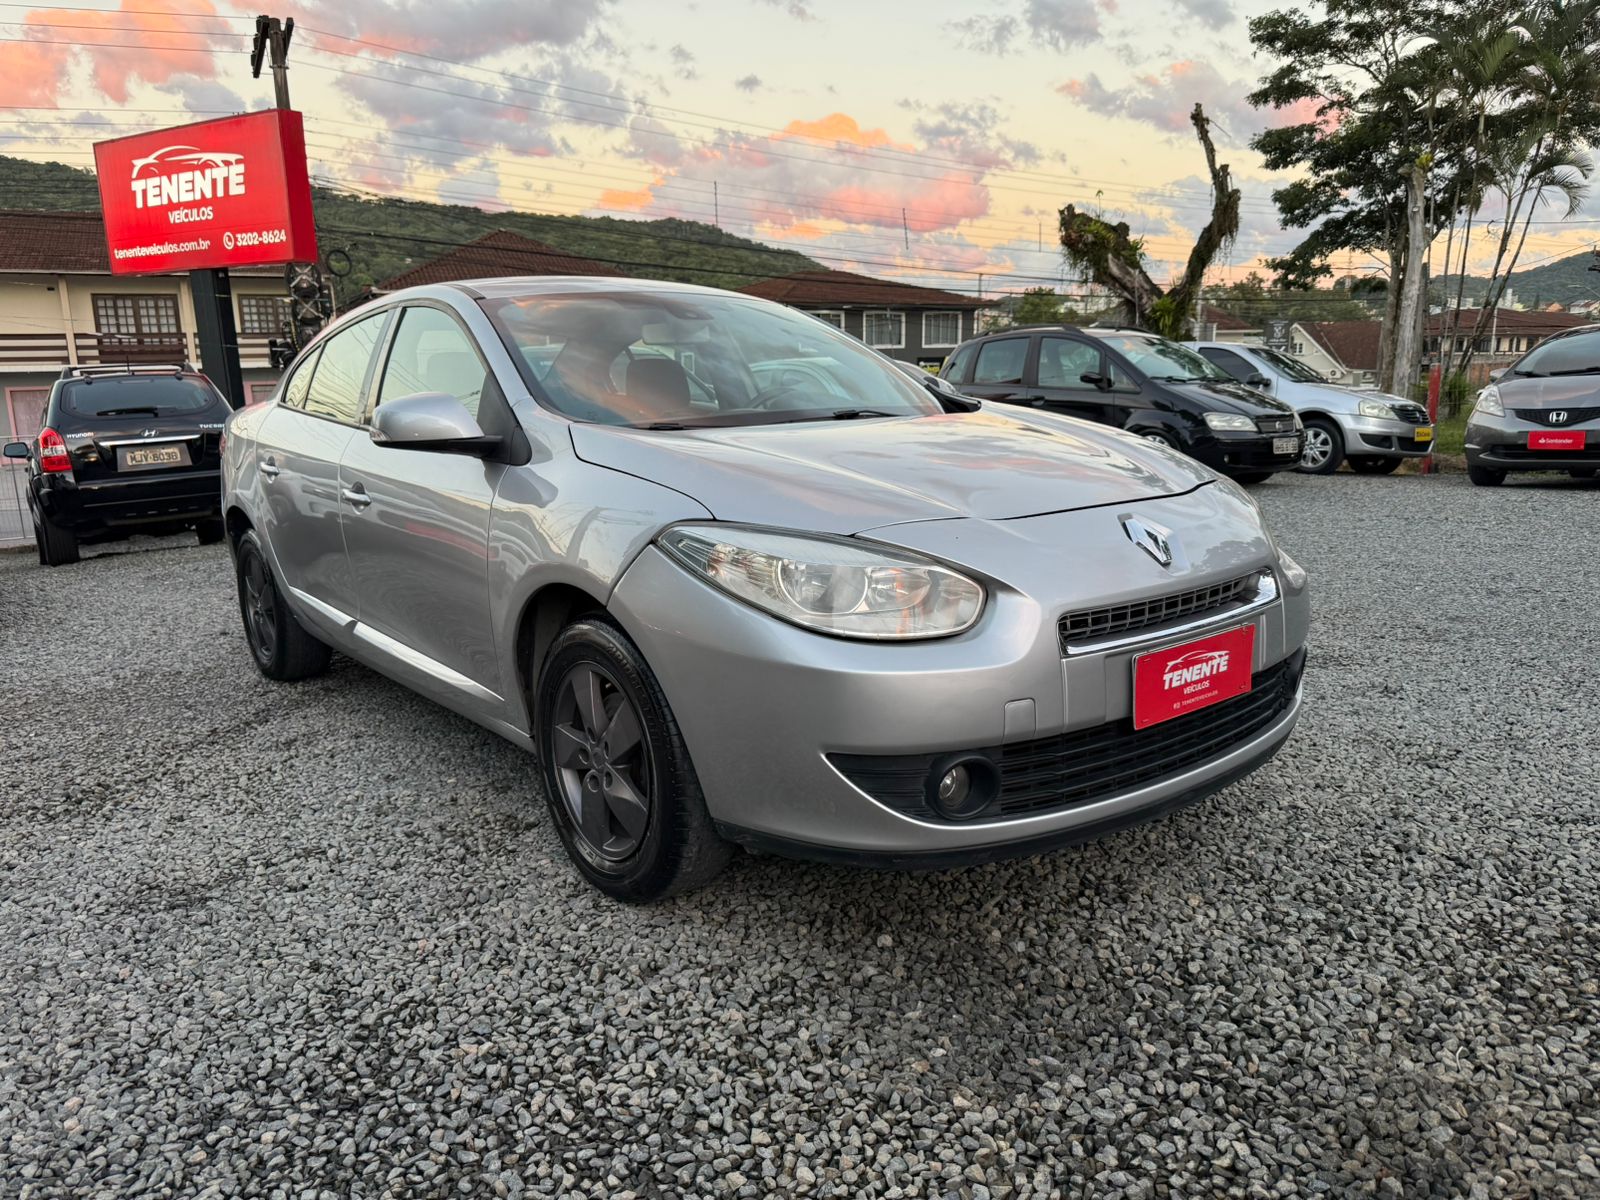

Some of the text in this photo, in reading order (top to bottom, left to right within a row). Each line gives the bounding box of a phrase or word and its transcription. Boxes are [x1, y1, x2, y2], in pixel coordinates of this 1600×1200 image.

[131, 164, 245, 208] TENENTE
[168, 206, 214, 224] VEÍCULOS
[235, 229, 287, 247] 3202-8624
[114, 238, 211, 259] tenenteveiculos.com.br
[1163, 654, 1229, 690] TENENTE
[1183, 680, 1210, 695] VEÍCULOS
